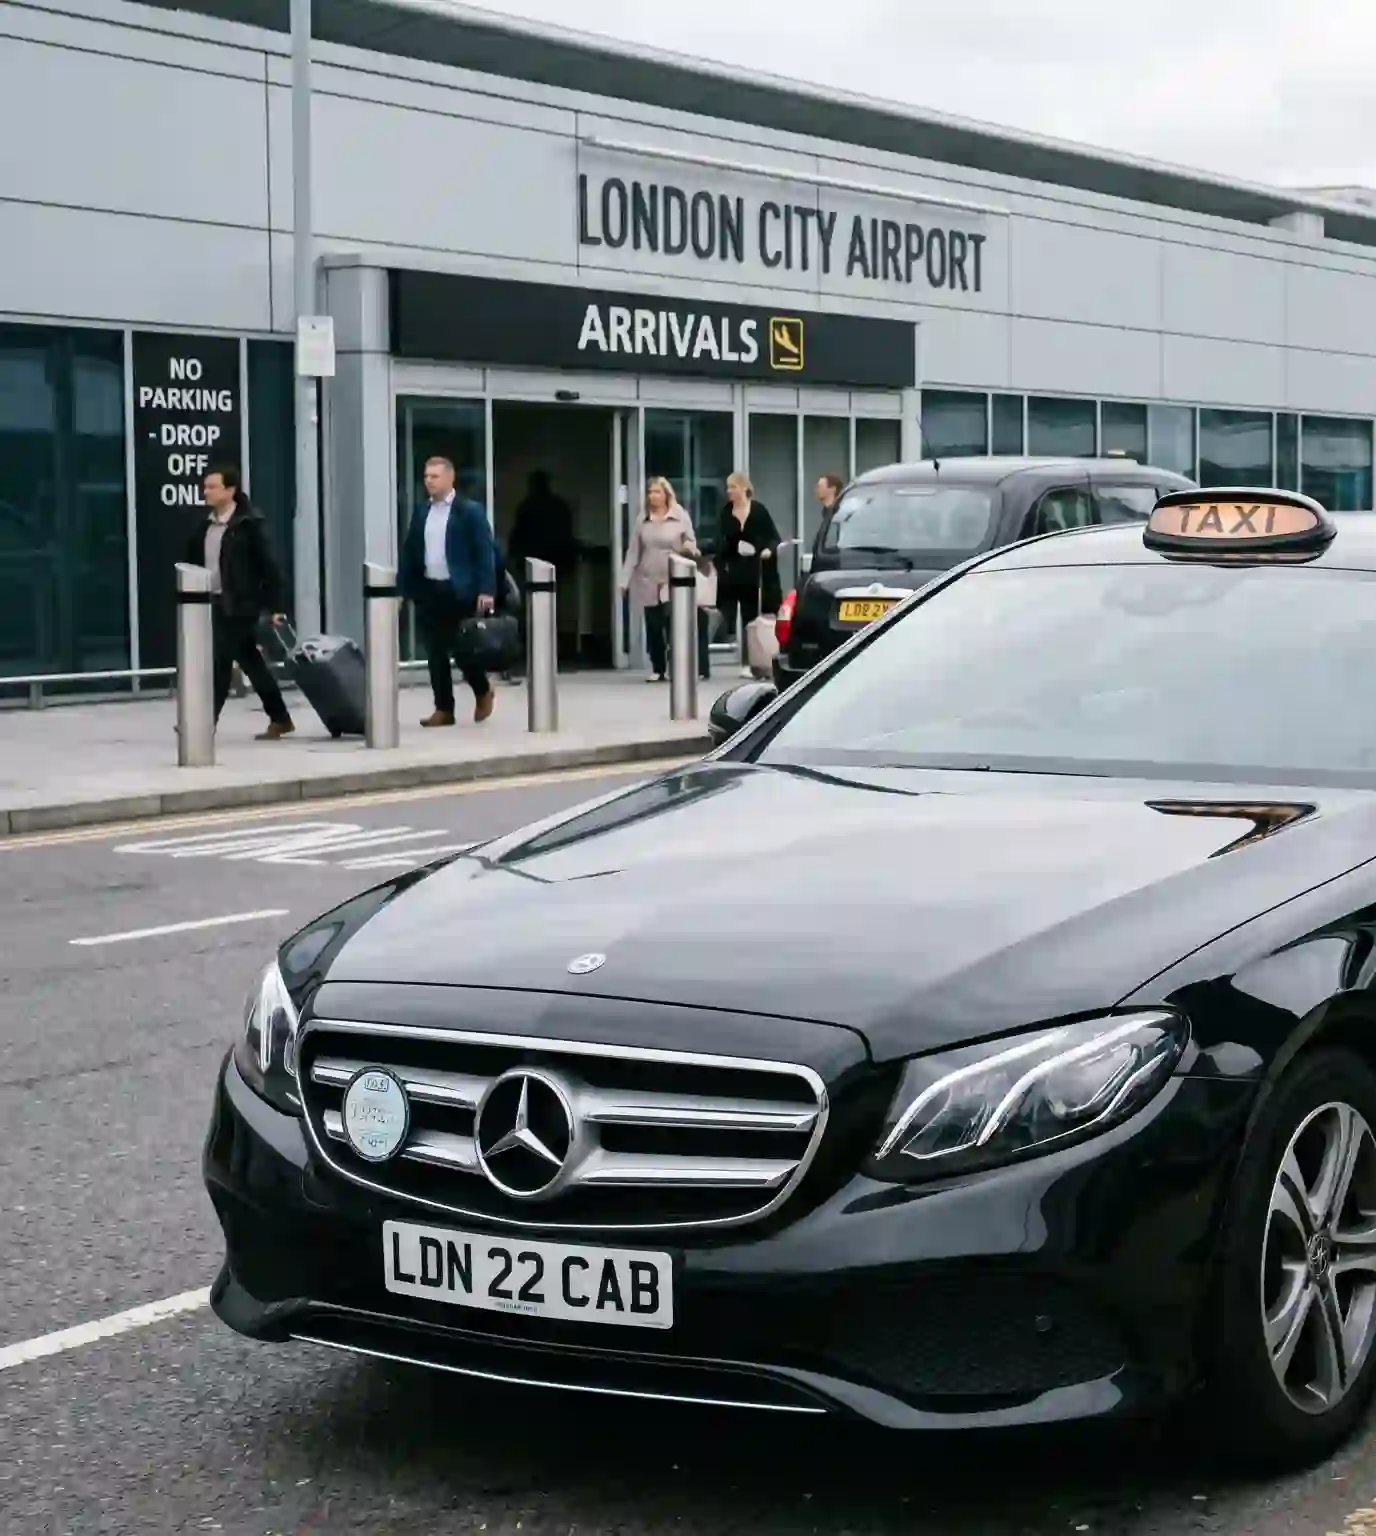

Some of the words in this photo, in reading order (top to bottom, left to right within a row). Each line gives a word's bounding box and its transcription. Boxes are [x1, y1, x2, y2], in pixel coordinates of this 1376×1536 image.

[579, 173, 745, 263] LONDON
[759, 201, 838, 274] CITY
[847, 214, 987, 293] AIRPORT
[577, 304, 759, 364] ARRIVALS
[169, 357, 203, 381] NO
[139, 386, 233, 412] PARKING
[160, 423, 221, 447] DROP
[167, 453, 209, 477] OFF
[160, 483, 206, 506] ONL
[1178, 504, 1277, 535] TAXI
[392, 1231, 473, 1294] LDN
[487, 1247, 545, 1304] 22
[561, 1255, 660, 1315] CAB
